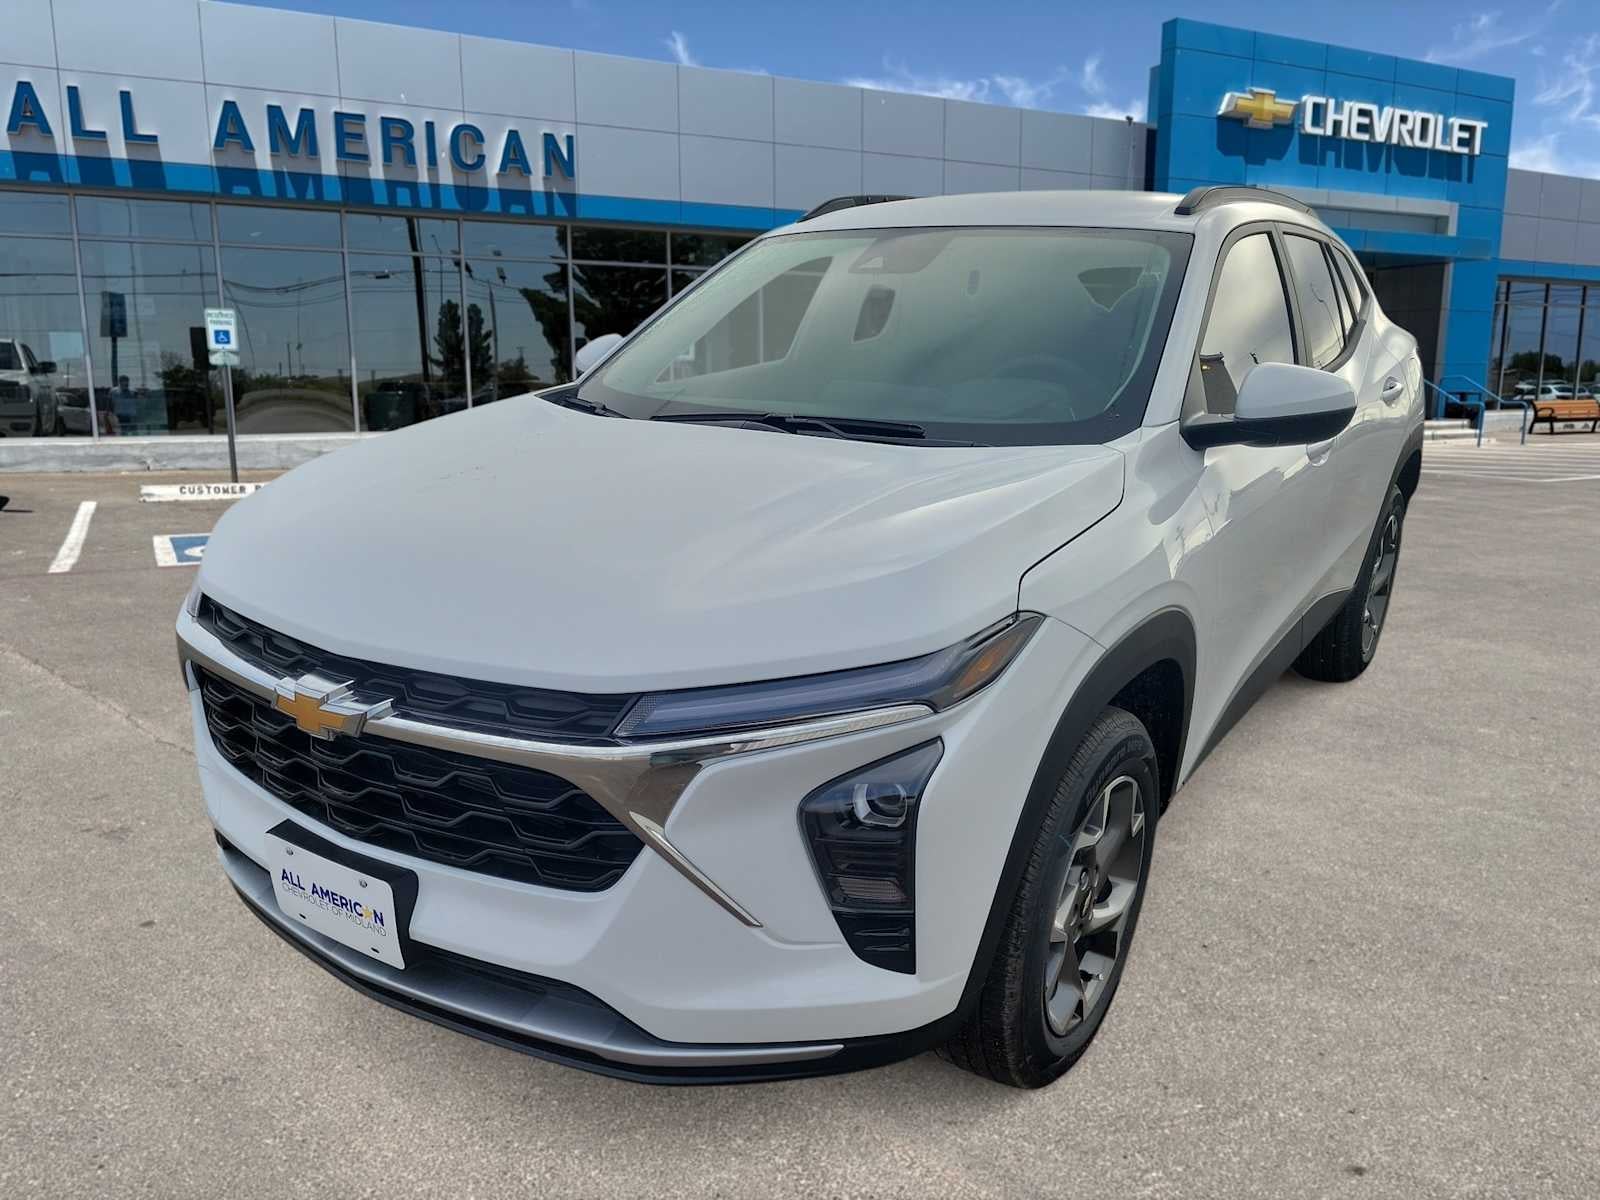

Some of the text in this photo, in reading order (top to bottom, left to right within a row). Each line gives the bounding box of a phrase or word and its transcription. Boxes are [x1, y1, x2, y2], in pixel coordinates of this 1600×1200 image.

[7, 80, 576, 178] ALL AMERICAN
[1301, 94, 1488, 155] CHEVROLET
[179, 485, 247, 495] CUSTOMER
[281, 868, 385, 927] ALL AMERICN
[281, 882, 387, 937] CHEVROLET OF MIDLAND
